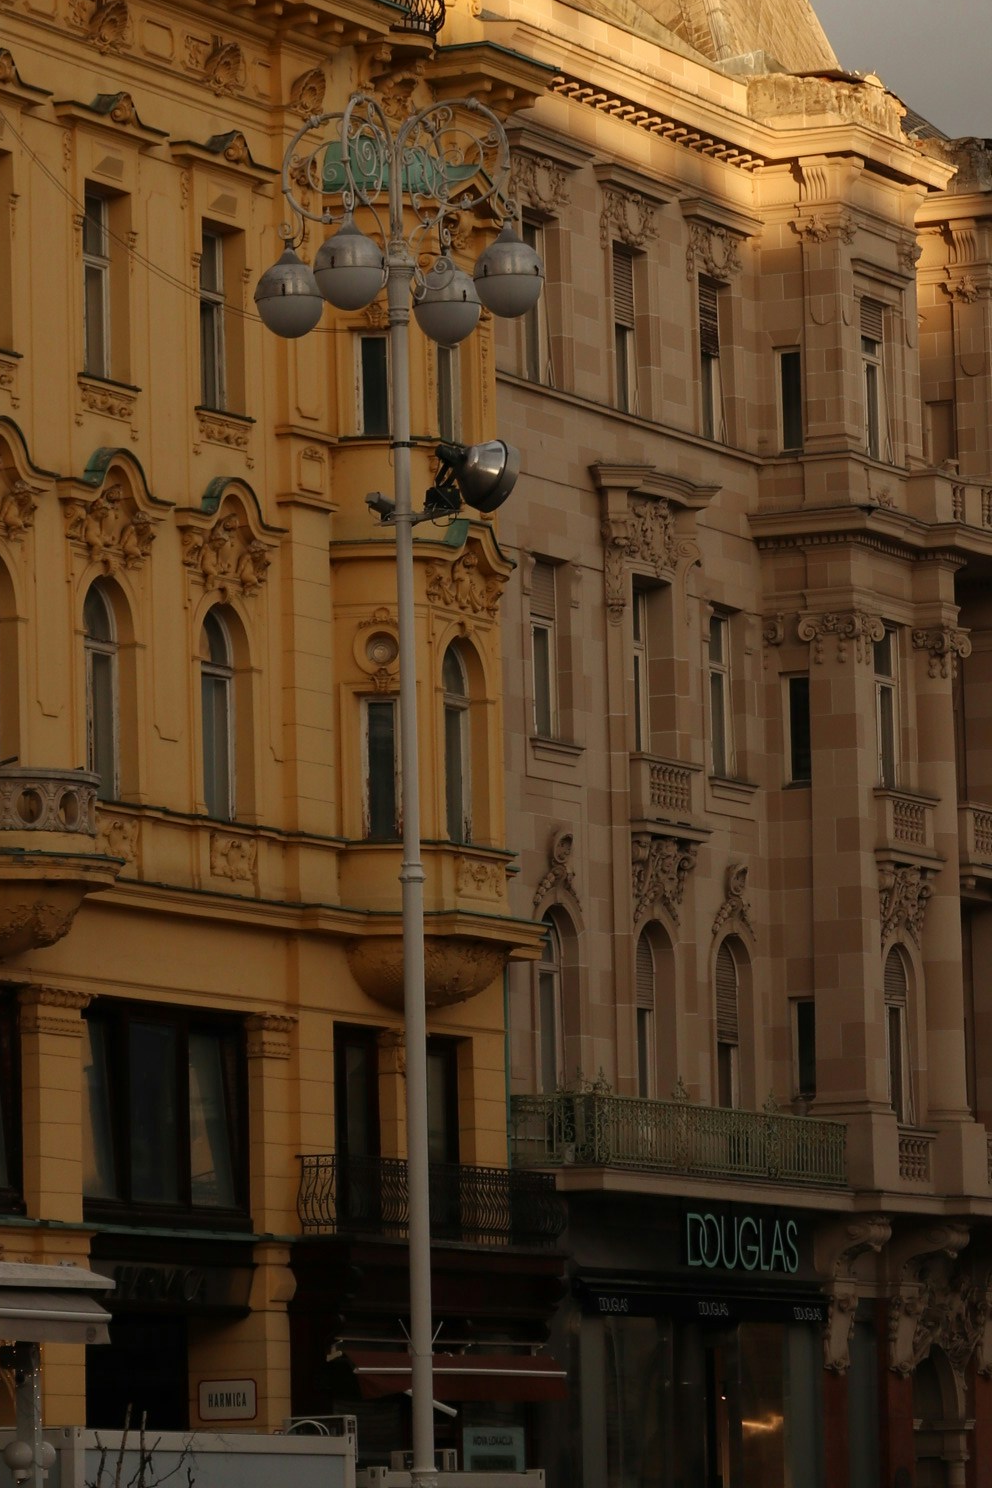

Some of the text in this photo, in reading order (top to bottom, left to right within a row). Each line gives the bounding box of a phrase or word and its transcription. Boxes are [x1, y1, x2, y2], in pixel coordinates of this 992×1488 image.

[686, 1212, 799, 1274] DOUGLAS
[598, 1296, 629, 1312] DOUGLAS
[698, 1301, 729, 1317] DOUGLAS
[793, 1306, 823, 1321] DOUGLAS
[208, 1392, 247, 1408] HARMICA
